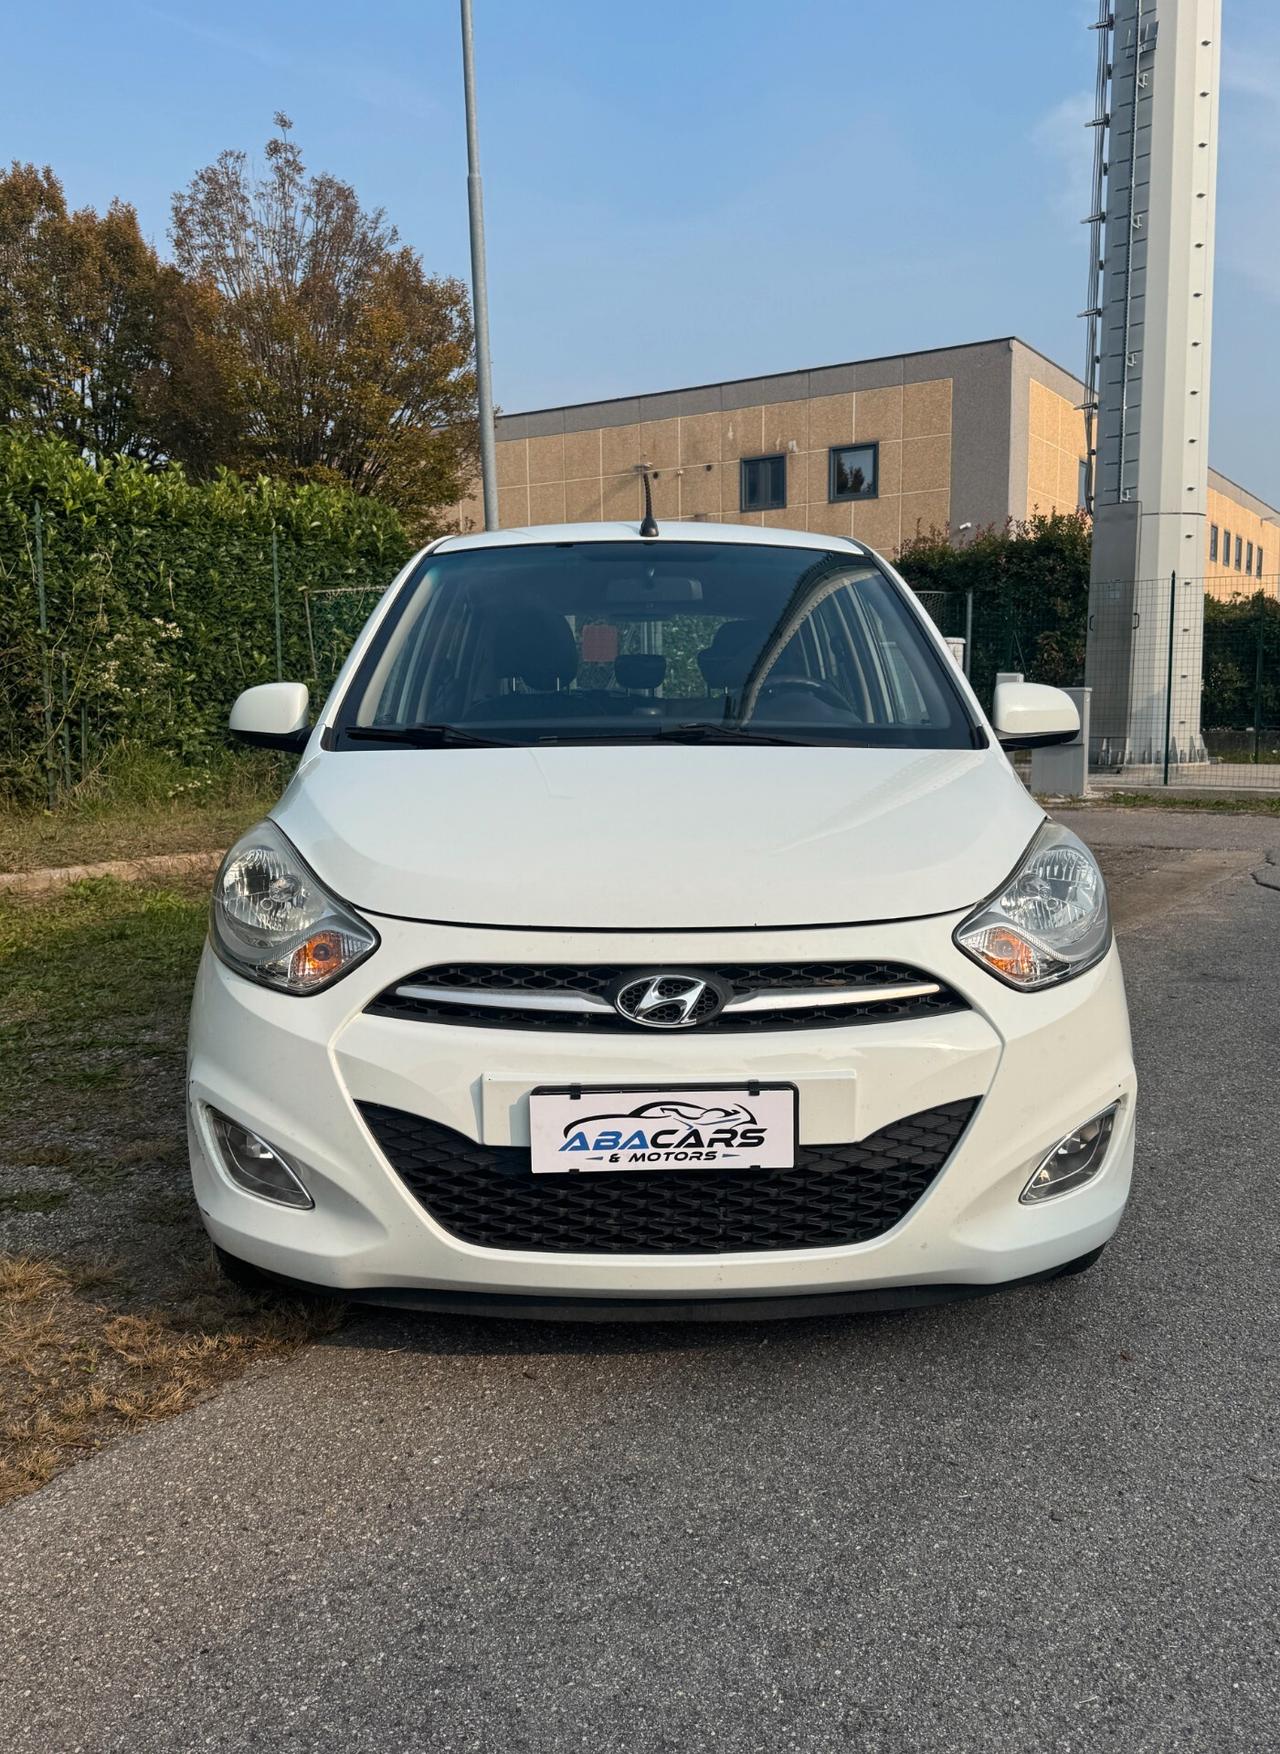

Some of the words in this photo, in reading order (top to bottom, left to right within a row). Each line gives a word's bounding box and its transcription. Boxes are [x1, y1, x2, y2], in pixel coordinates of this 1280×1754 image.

[558, 1128, 768, 1152] ABACARS
[608, 1153, 621, 1163] &
[628, 1151, 718, 1163] MOTORS
